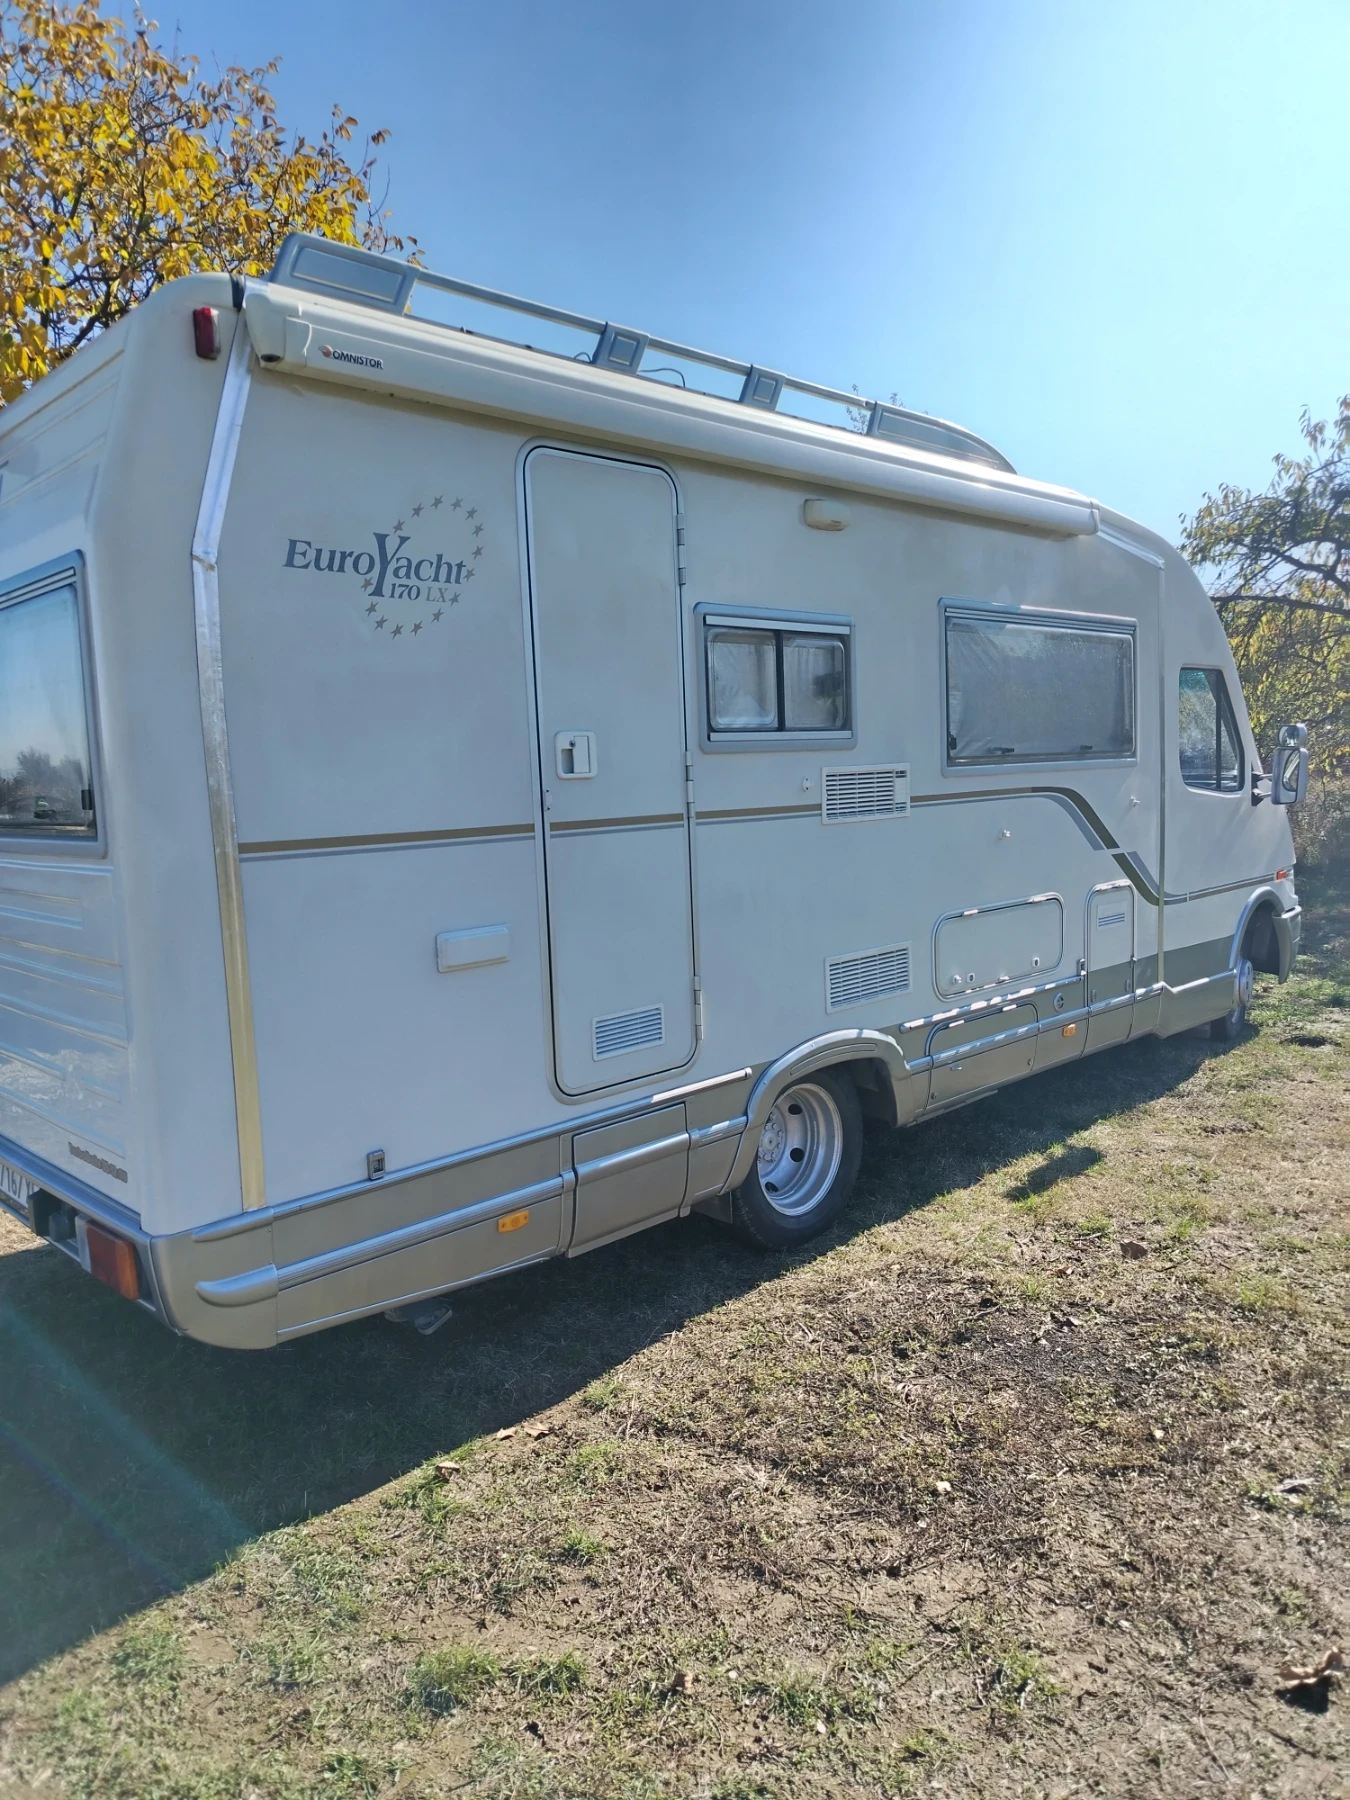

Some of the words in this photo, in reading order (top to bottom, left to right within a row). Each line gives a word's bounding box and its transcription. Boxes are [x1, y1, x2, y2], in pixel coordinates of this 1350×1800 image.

[333, 350, 383, 369] OMNISTOR
[282, 532, 466, 598] EuroYacht
[388, 583, 421, 601] 170
[425, 587, 449, 603] LX
